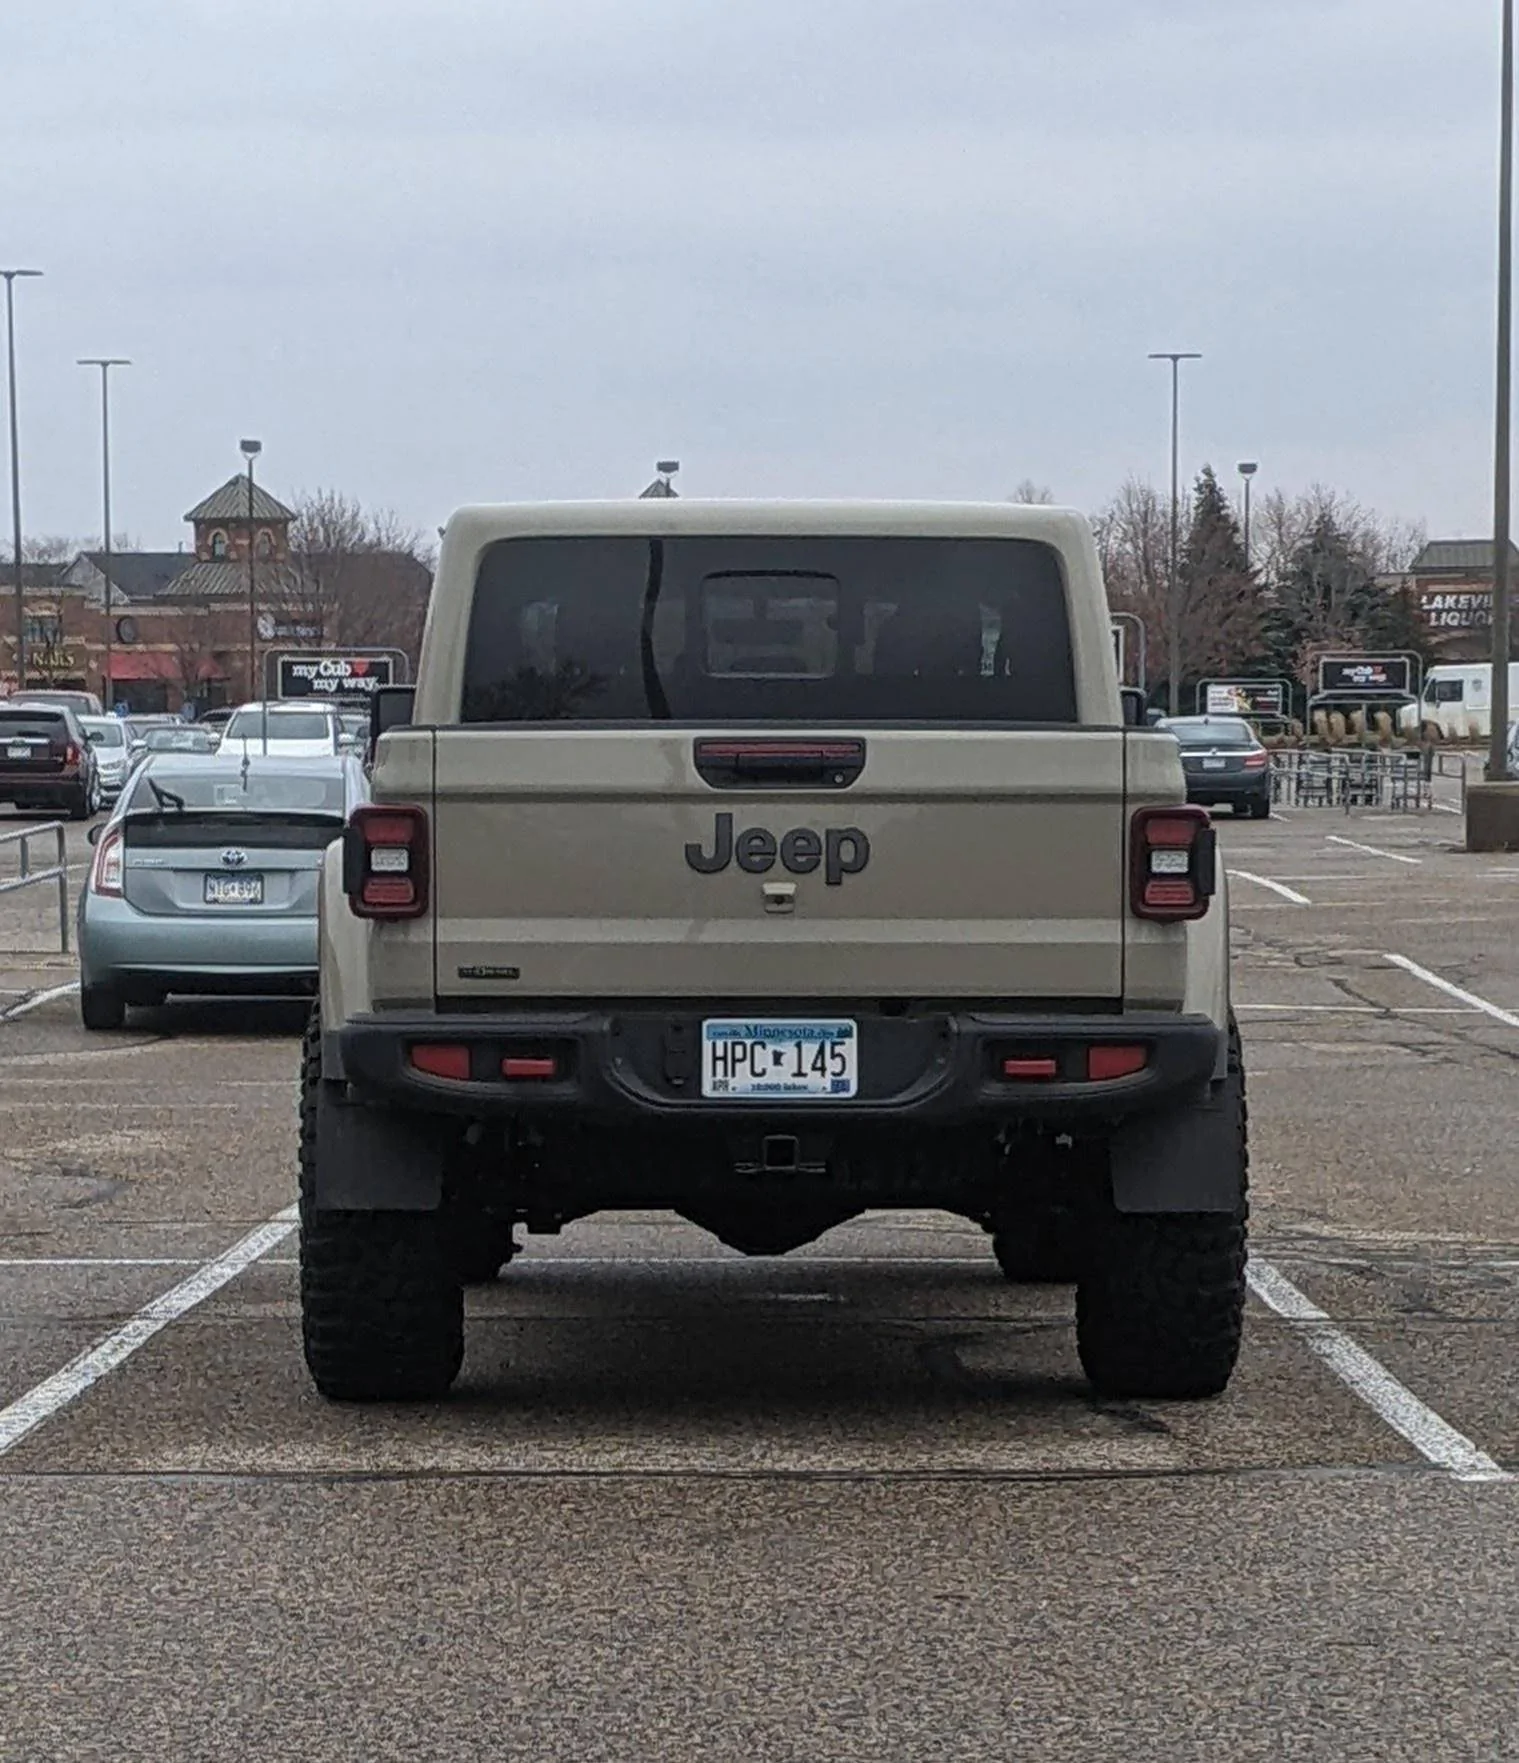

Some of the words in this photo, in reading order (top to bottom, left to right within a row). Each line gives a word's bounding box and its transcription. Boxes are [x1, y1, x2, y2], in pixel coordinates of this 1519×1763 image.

[312, 678, 339, 692] my
[685, 812, 870, 885] Jeep
[743, 1023, 815, 1039] Minnesota
[711, 1041, 768, 1078] HPC
[791, 1041, 847, 1078] 145
